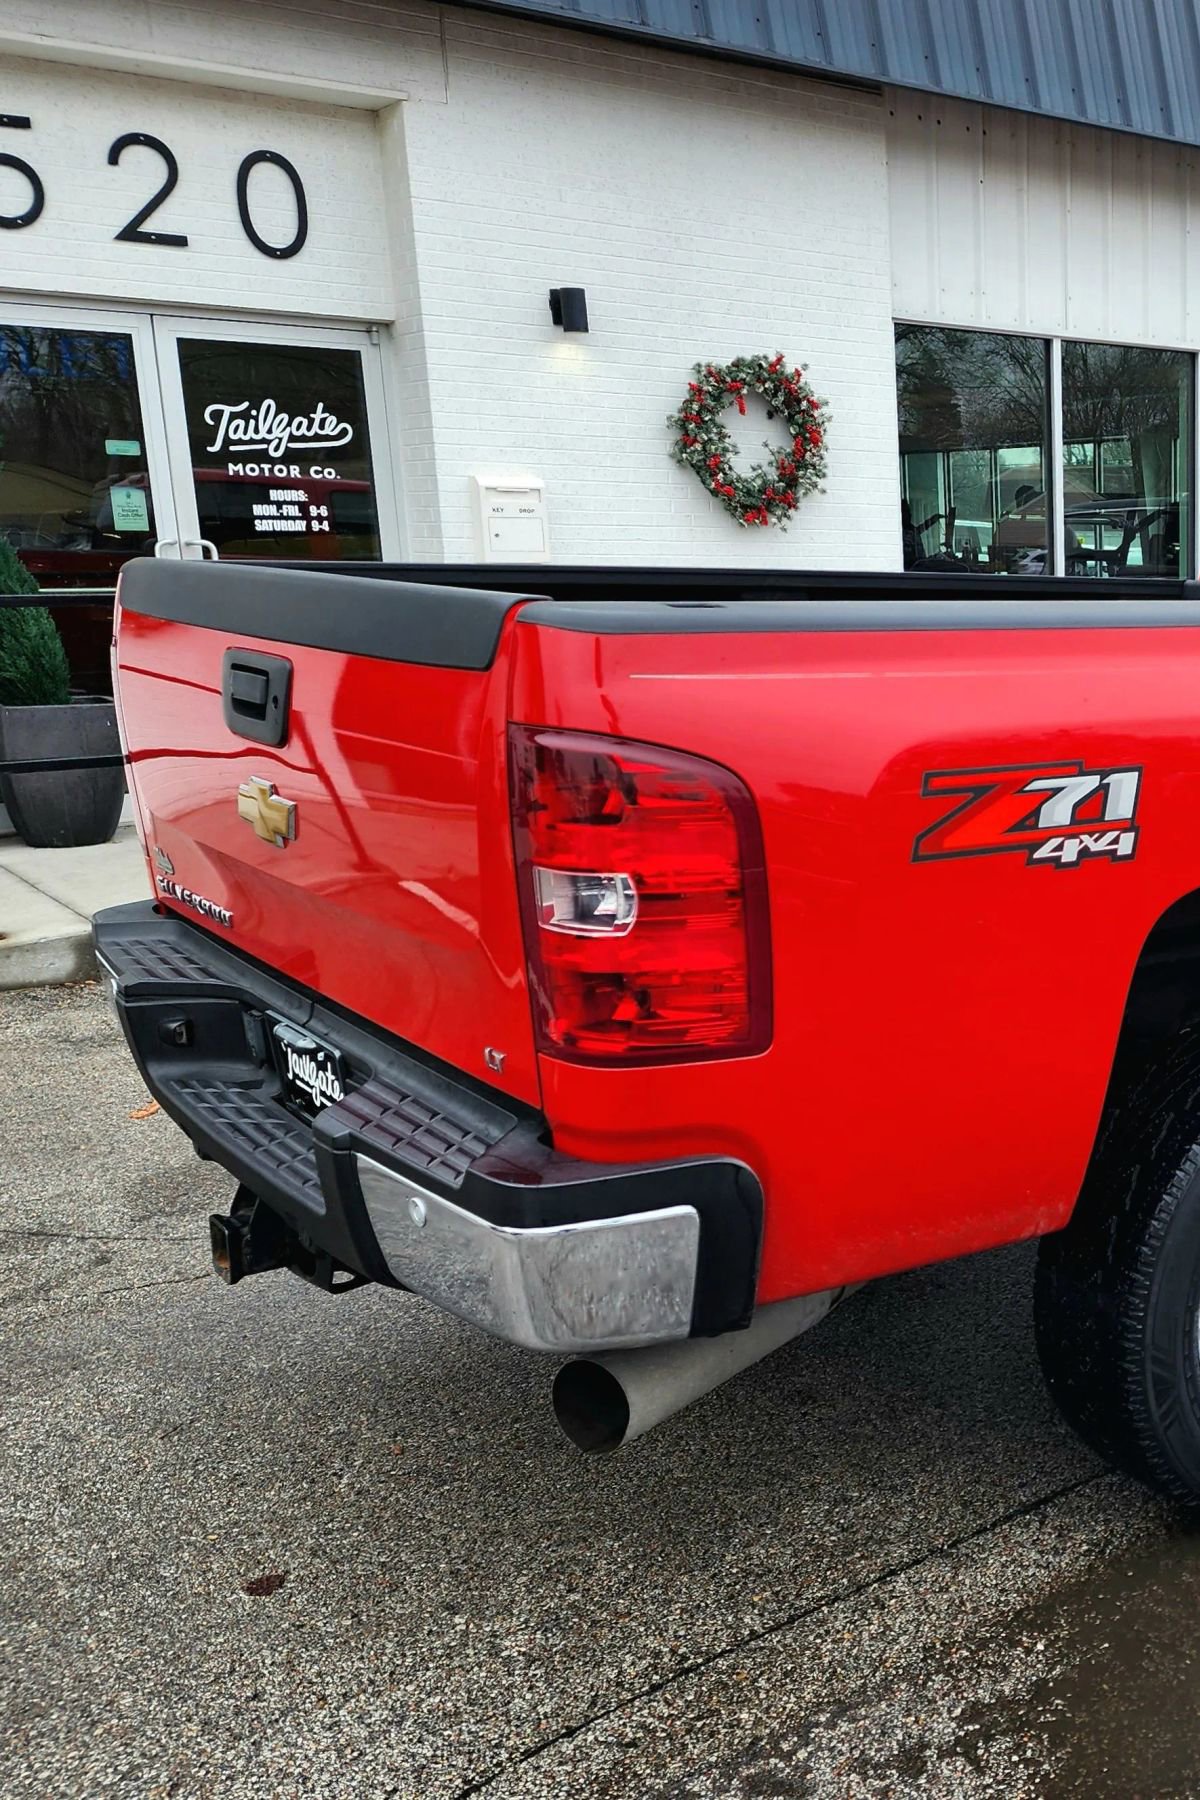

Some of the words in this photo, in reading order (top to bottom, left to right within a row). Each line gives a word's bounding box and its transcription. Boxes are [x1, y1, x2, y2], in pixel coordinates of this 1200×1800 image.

[0, 113, 308, 259] 520
[203, 398, 354, 458] Tailgate
[227, 462, 302, 478] MOTOR
[309, 465, 341, 479] CO.
[269, 489, 309, 502] HOURS:
[309, 505, 328, 517] 9-6
[254, 519, 307, 532] SATURDAY
[311, 520, 330, 532] 9-4
[910, 759, 1144, 864] Z71
[280, 1039, 346, 1108] Tailgate
